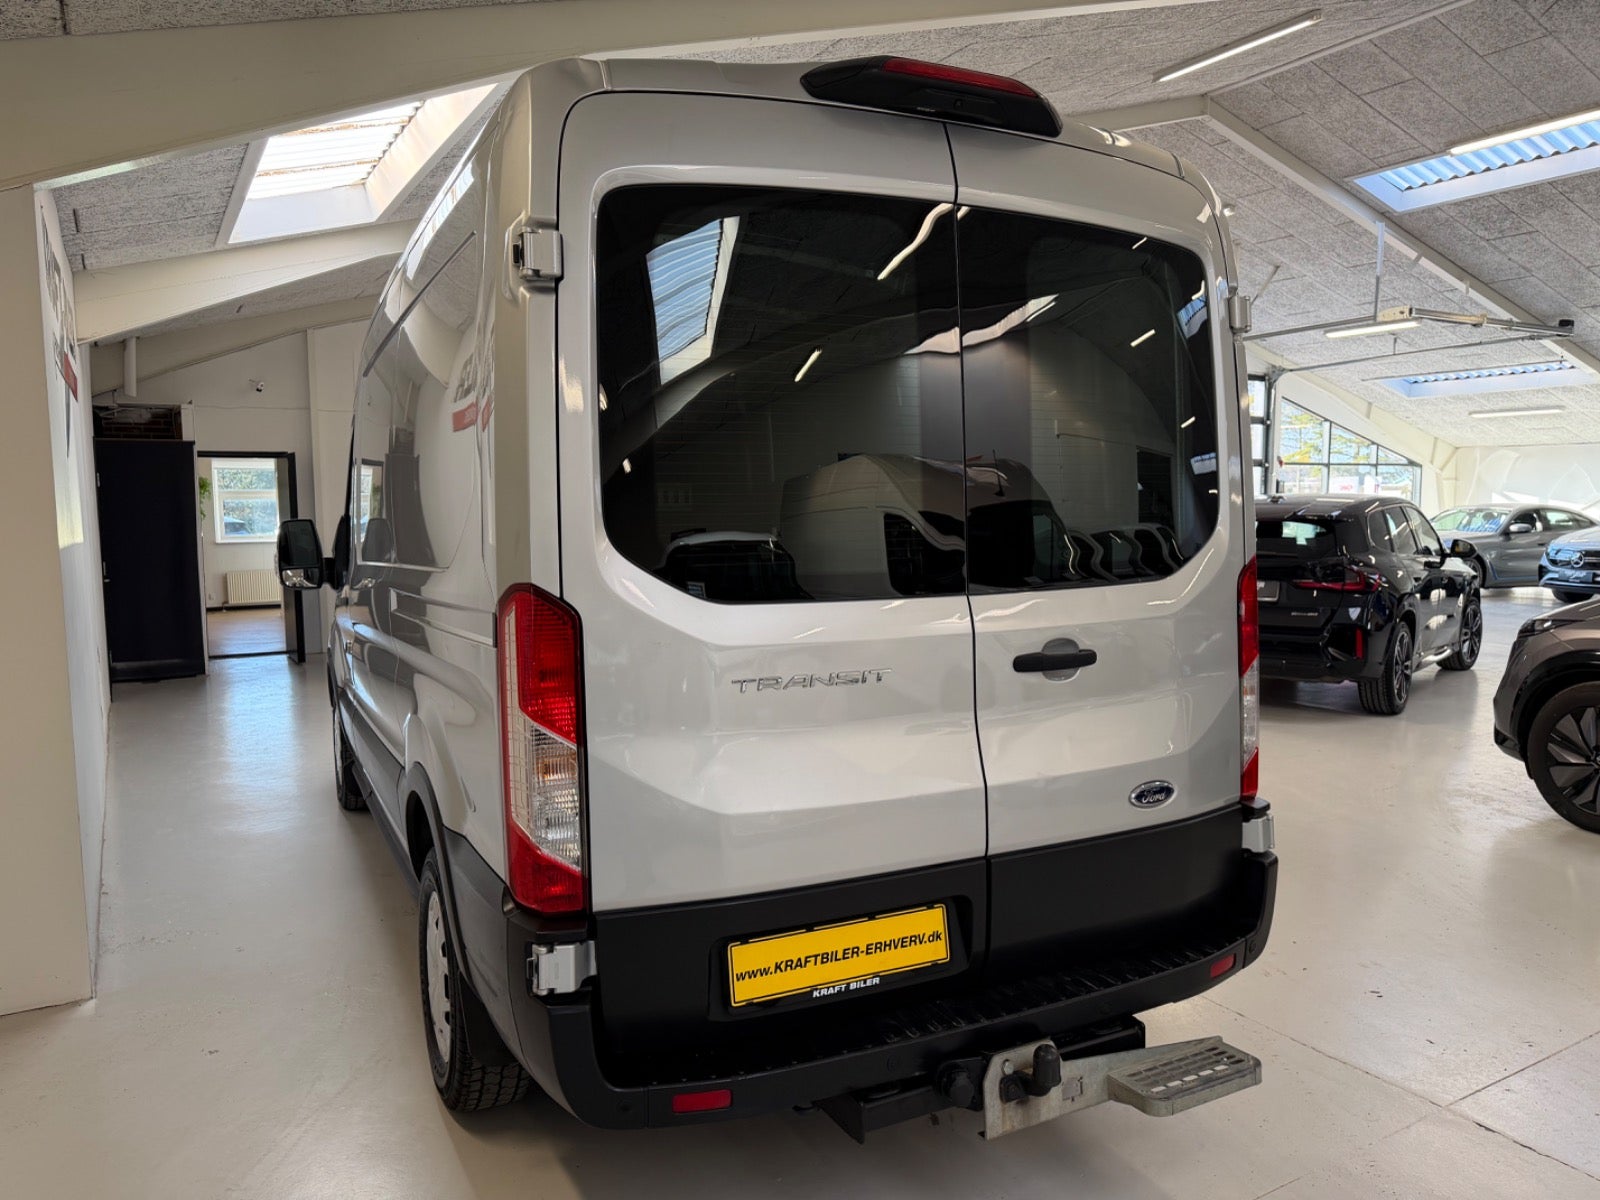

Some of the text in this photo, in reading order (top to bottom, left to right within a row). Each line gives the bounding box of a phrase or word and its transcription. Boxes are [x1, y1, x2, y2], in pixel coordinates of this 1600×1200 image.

[732, 668, 892, 694] TRANSIT
[735, 930, 943, 982] www.KRAFTBILER-ERHVERV.dk
[812, 976, 880, 998] KRAFT BILER
